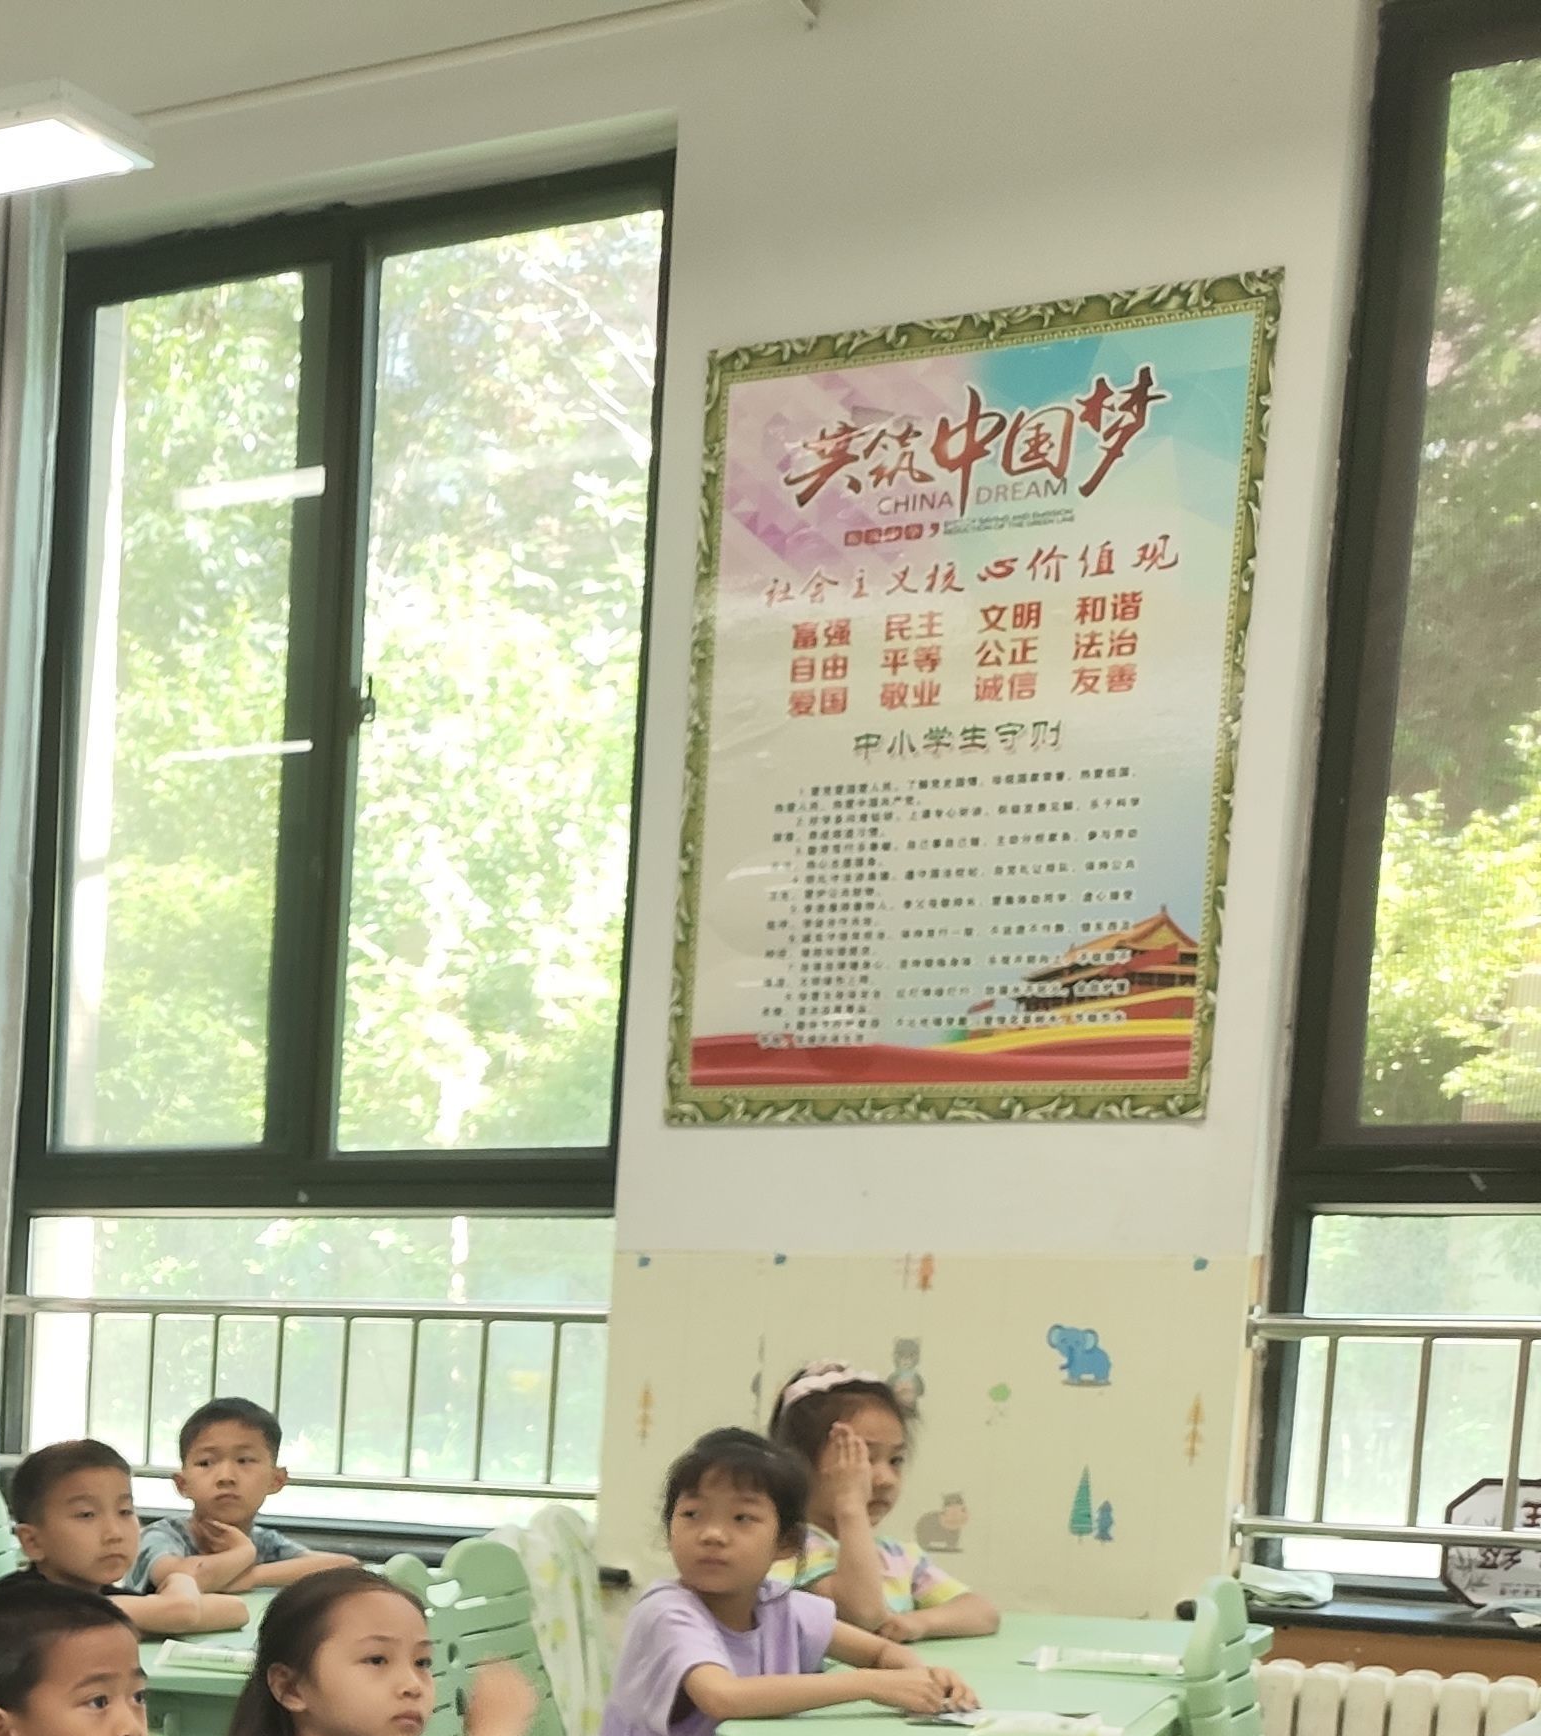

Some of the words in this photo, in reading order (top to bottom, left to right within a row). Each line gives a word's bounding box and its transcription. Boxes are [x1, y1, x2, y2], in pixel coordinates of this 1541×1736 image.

[878, 491, 953, 515] CHINA
[975, 478, 1067, 505] DREAM
[764, 534, 1179, 606] 社会主义核心价值观
[791, 617, 851, 650] 富强
[884, 610, 944, 642] 民主
[977, 601, 1043, 633] 文明
[1074, 590, 1143, 624] 和谐
[790, 654, 849, 683] 自由
[880, 645, 942, 675] 平等
[975, 636, 1039, 667] 公正
[1072, 628, 1139, 660] 法治
[788, 685, 849, 718] 爱国
[879, 681, 941, 711] 敬业
[974, 672, 1039, 703] 诚信
[1069, 663, 1138, 696] 友善
[852, 719, 1063, 760] 中小学生守则
